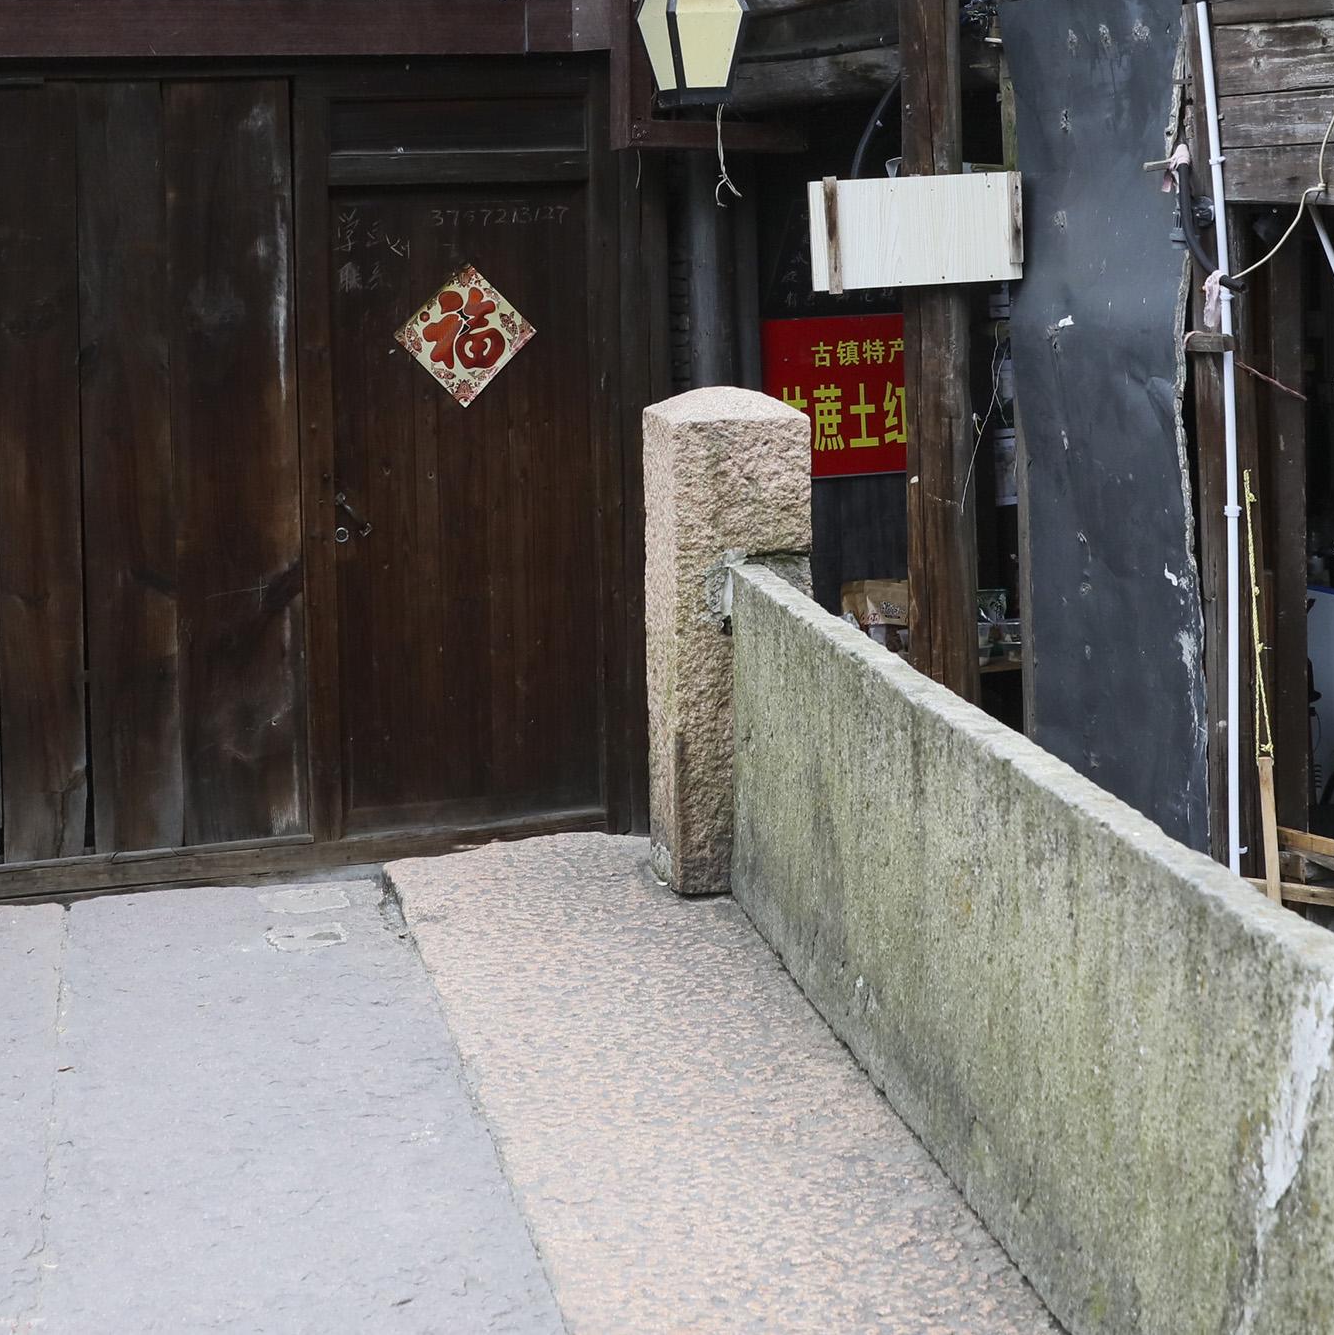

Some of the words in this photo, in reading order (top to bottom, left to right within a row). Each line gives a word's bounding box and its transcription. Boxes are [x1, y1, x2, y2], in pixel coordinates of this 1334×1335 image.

[422, 286, 506, 370] 福
[811, 338, 905, 368] 古镇特产
